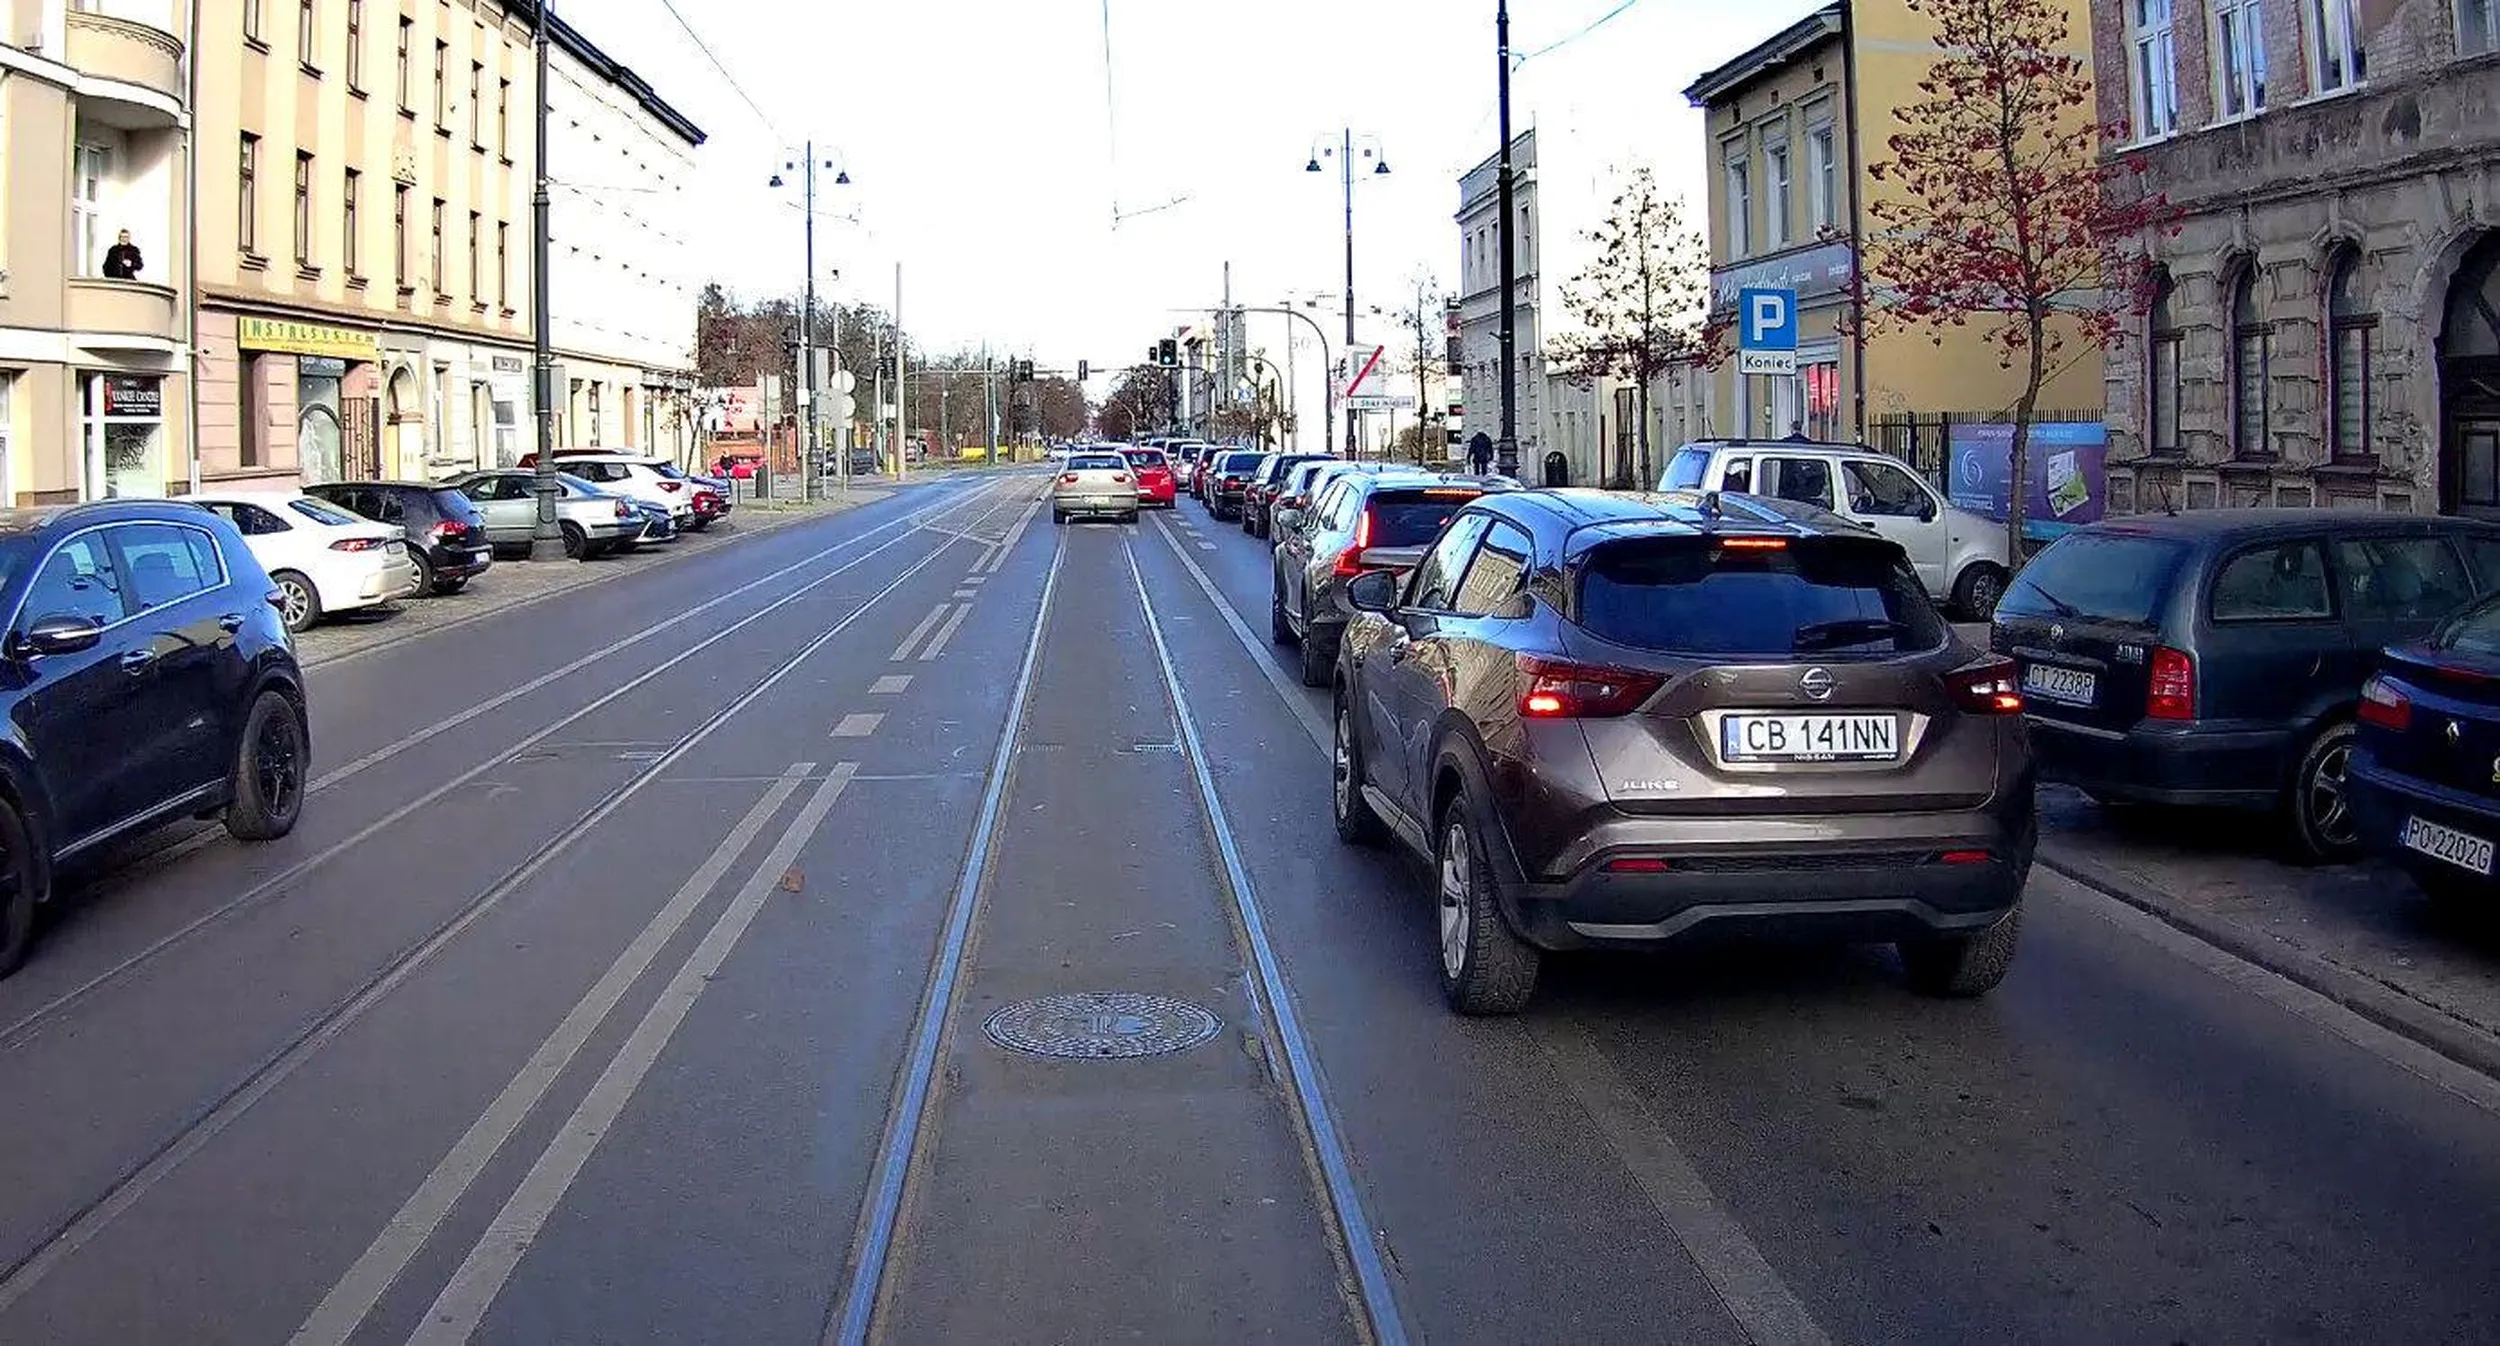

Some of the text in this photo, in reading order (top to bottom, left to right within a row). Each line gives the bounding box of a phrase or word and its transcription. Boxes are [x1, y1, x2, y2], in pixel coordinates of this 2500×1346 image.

[1753, 295, 1784, 341] P
[1745, 355, 1793, 369] Koniec
[2031, 665, 2049, 686] CT
[1747, 719, 1890, 751] CB 141NN
[2407, 819, 2491, 870] PO 2202G
